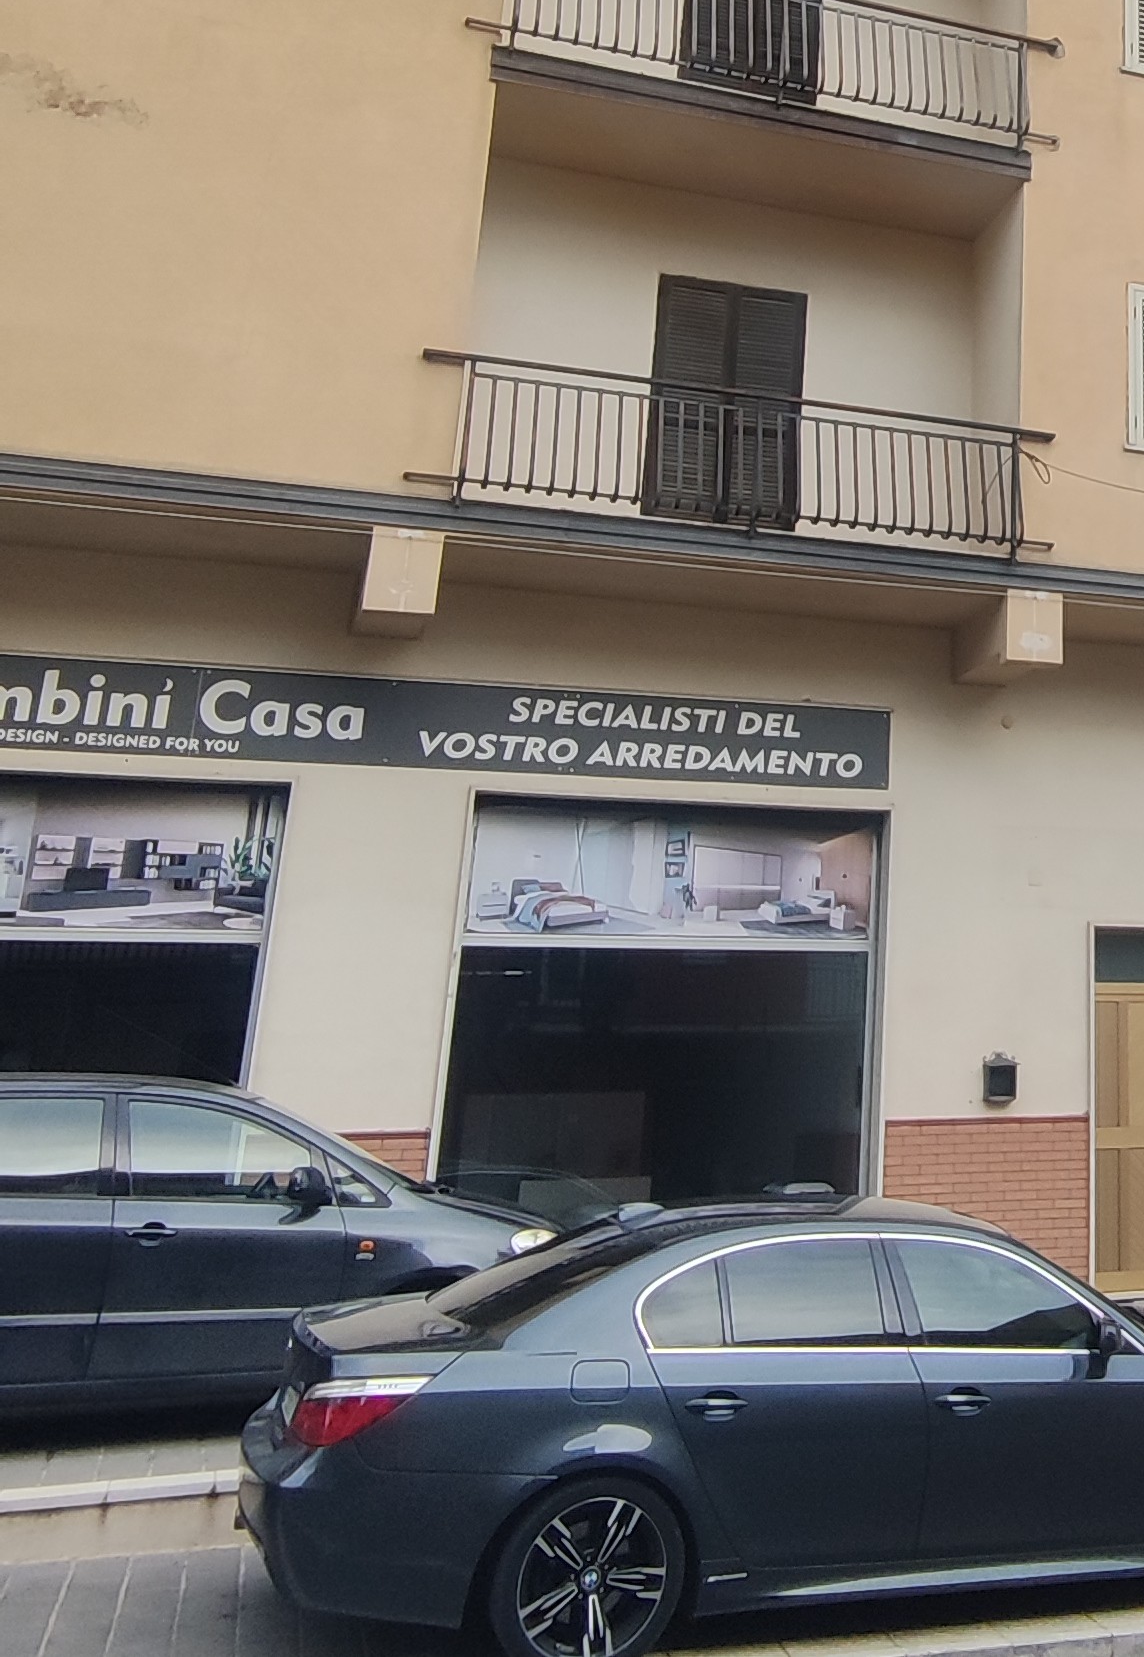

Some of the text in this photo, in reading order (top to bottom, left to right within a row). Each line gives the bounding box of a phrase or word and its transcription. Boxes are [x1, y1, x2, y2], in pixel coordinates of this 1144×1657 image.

[200, 679, 365, 741] Casa
[508, 696, 801, 739] SPECIALISTI DEL
[74, 731, 161, 750] DESIGNED
[164, 736, 200, 752] FOR
[203, 738, 240, 753] YOU
[418, 730, 863, 779] VOSTRO ARREDAMENTO
